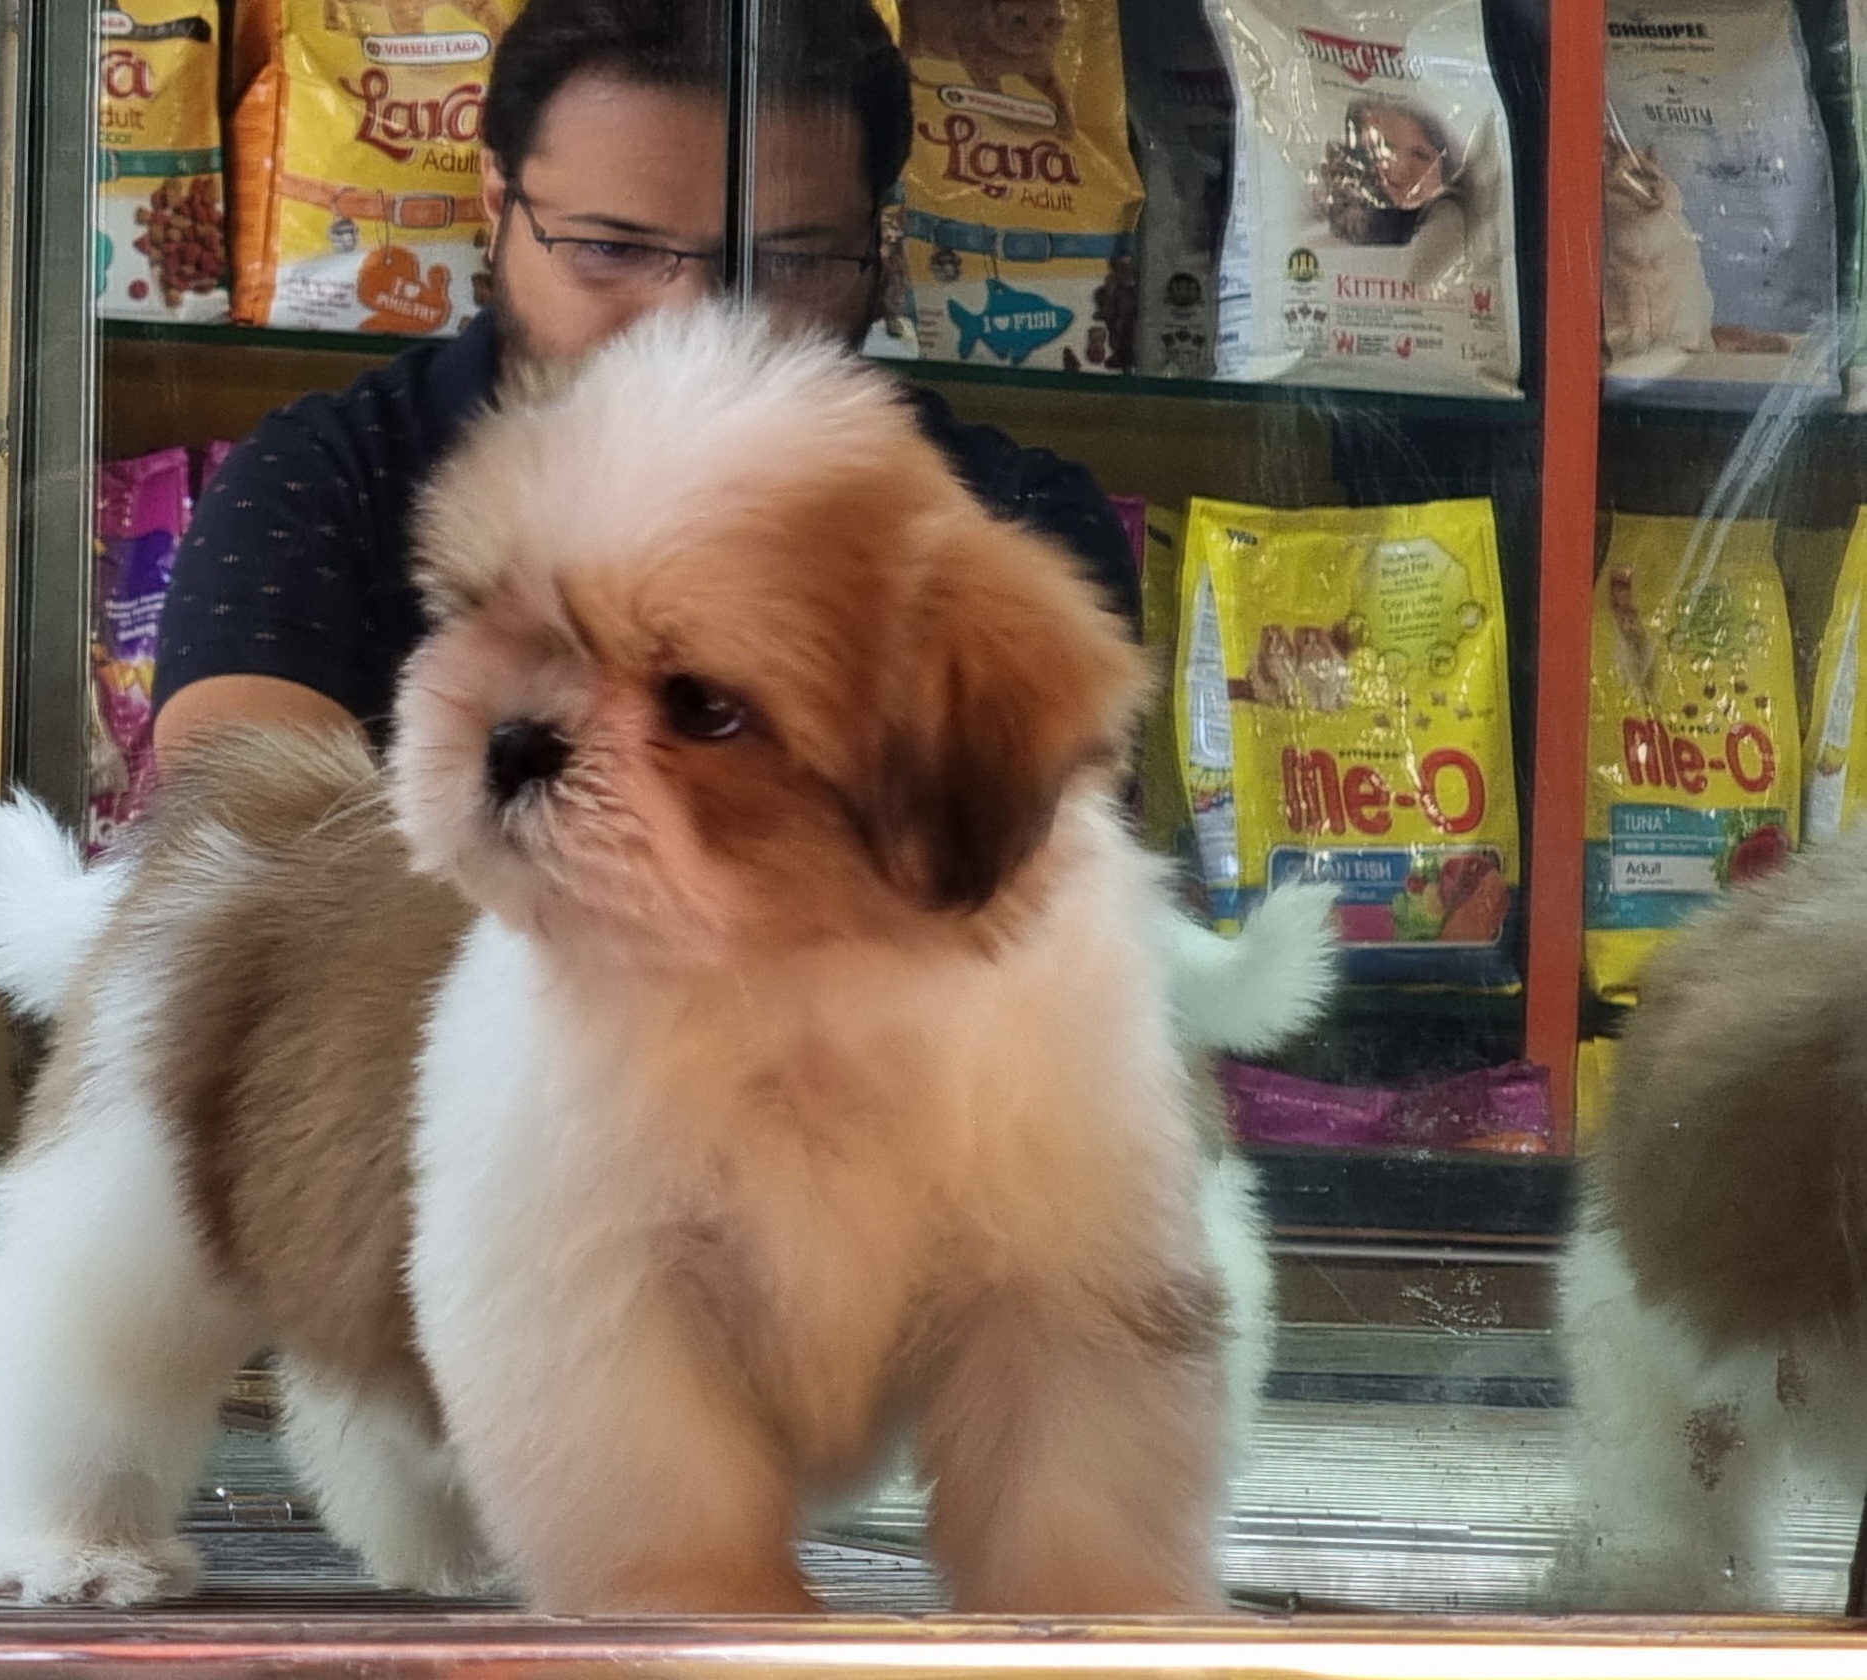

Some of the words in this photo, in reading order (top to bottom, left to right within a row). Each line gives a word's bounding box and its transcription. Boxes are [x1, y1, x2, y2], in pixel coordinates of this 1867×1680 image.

[1607, 22, 1709, 39] CHICOPEE
[99, 103, 145, 130] dult
[337, 68, 487, 164] Lara
[917, 114, 1082, 199] Lara
[1019, 187, 1078, 213] Adult
[1337, 274, 1416, 300] KITTEN
[984, 316, 992, 334] I
[1014, 311, 1058, 332] FISH
[1625, 814, 1663, 831] TUNA
[1355, 859, 1392, 880] FISH
